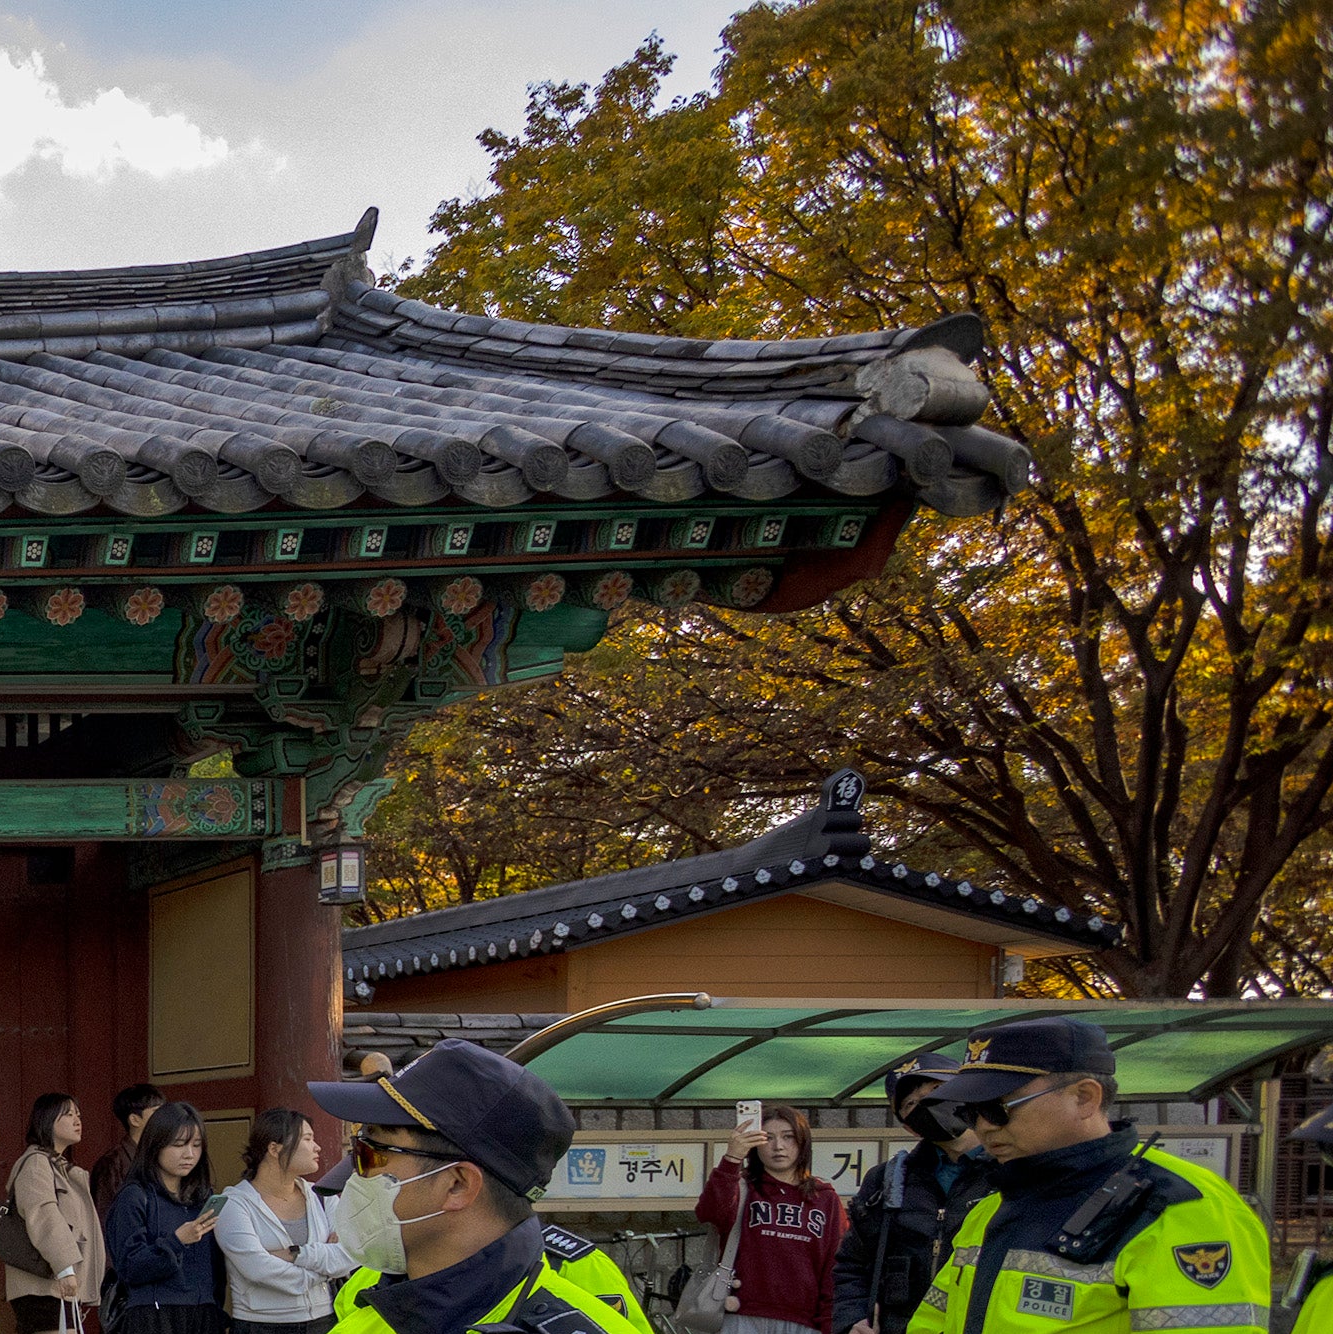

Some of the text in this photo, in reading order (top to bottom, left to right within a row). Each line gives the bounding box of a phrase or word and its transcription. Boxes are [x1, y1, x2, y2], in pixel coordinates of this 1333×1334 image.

[618, 1157, 685, 1183] 경주시
[831, 1149, 863, 1187] 거
[749, 1200, 827, 1239] NHS
[1027, 1280, 1070, 1304] 경찰
[1022, 1301, 1068, 1317] POLICE
